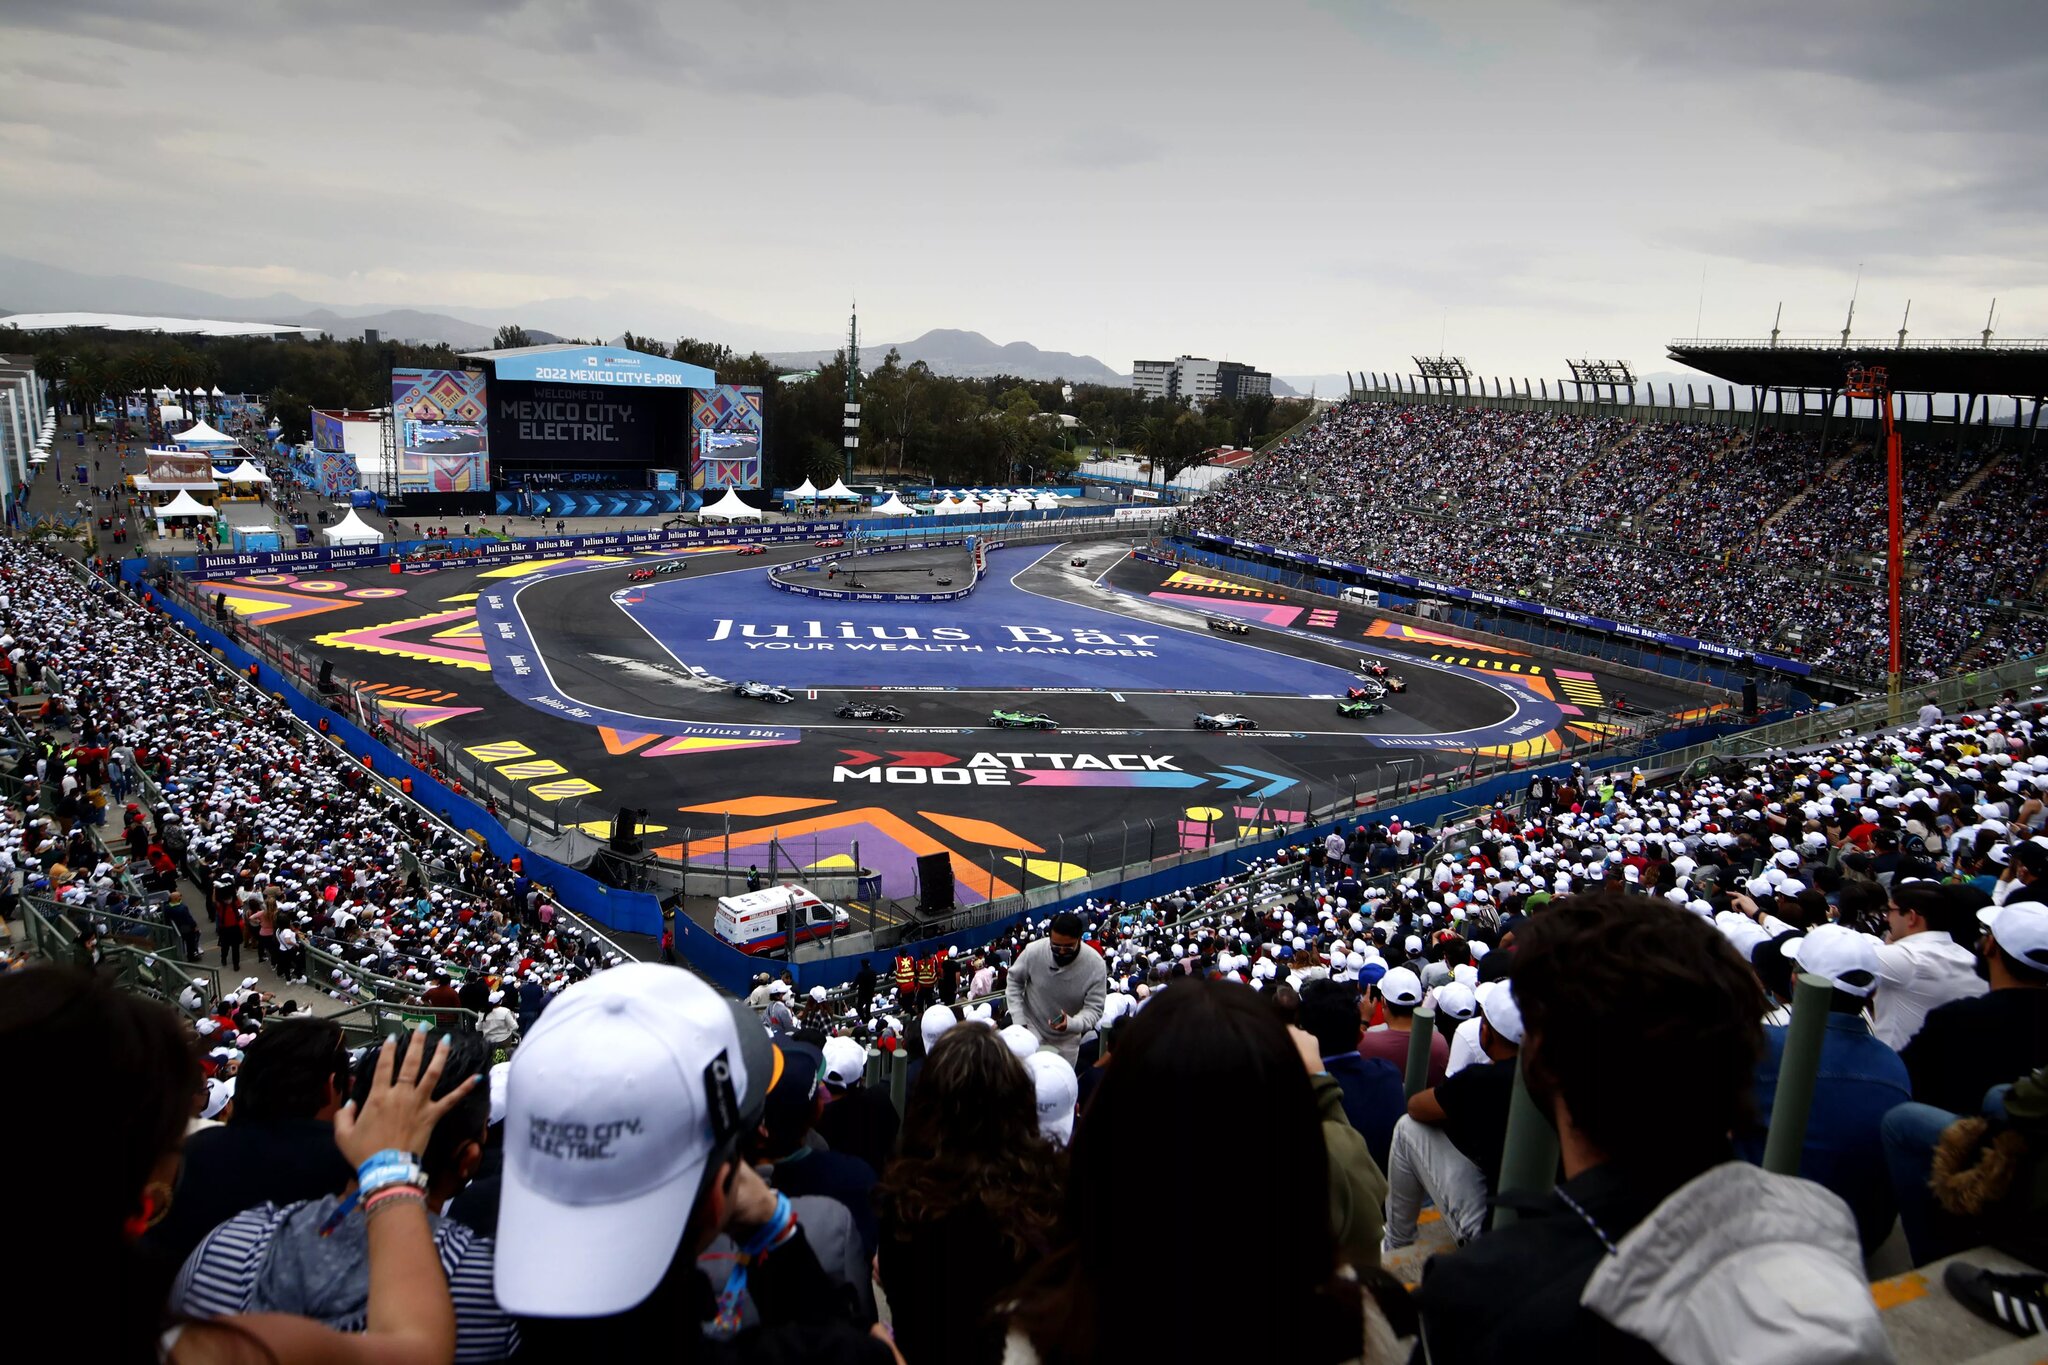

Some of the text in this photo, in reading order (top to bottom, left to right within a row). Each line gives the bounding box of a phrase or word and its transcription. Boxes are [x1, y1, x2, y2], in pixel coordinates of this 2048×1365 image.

[536, 368, 682, 384] 2022 MEXICO CITY E-PRIX
[534, 388, 604, 400] WELCOME TO
[501, 402, 635, 422] MEXICO CITY.
[520, 422, 619, 441] ELECTRIC.
[627, 532, 660, 543] Julius Bär
[668, 531, 686, 540] Julius
[708, 528, 724, 537] Julius
[745, 527, 761, 536] Julius
[536, 541, 557, 550] Julius
[583, 538, 604, 547] Julius
[330, 547, 374, 559] Julius Bär
[486, 544, 510, 554] Julius
[206, 556, 258, 568] Julius Bär
[271, 552, 318, 563] Julius Bär
[1366, 568, 1381, 576] Julius
[1418, 580, 1435, 588] Julius
[1436, 583, 1448, 591] Bär
[1472, 592, 1492, 601] Julius
[1494, 596, 1507, 604] Bär
[1543, 607, 1564, 618] Julius
[706, 619, 1159, 646] Julius Bär
[1616, 624, 1639, 634] Julius
[1642, 629, 1656, 638] Bär
[744, 642, 1158, 657] YOUR WEALTH MANAGER
[1698, 641, 1744, 658] Julius Bär
[529, 696, 591, 718] Julius Bär
[684, 726, 785, 738] Julius Bär
[1380, 738, 1466, 748] Julius Bär
[967, 752, 1184, 770] ATTACK
[832, 766, 1011, 785] MODE
[529, 1115, 588, 1139] MEXICO
[530, 1133, 617, 1160] ELECTRIC.
